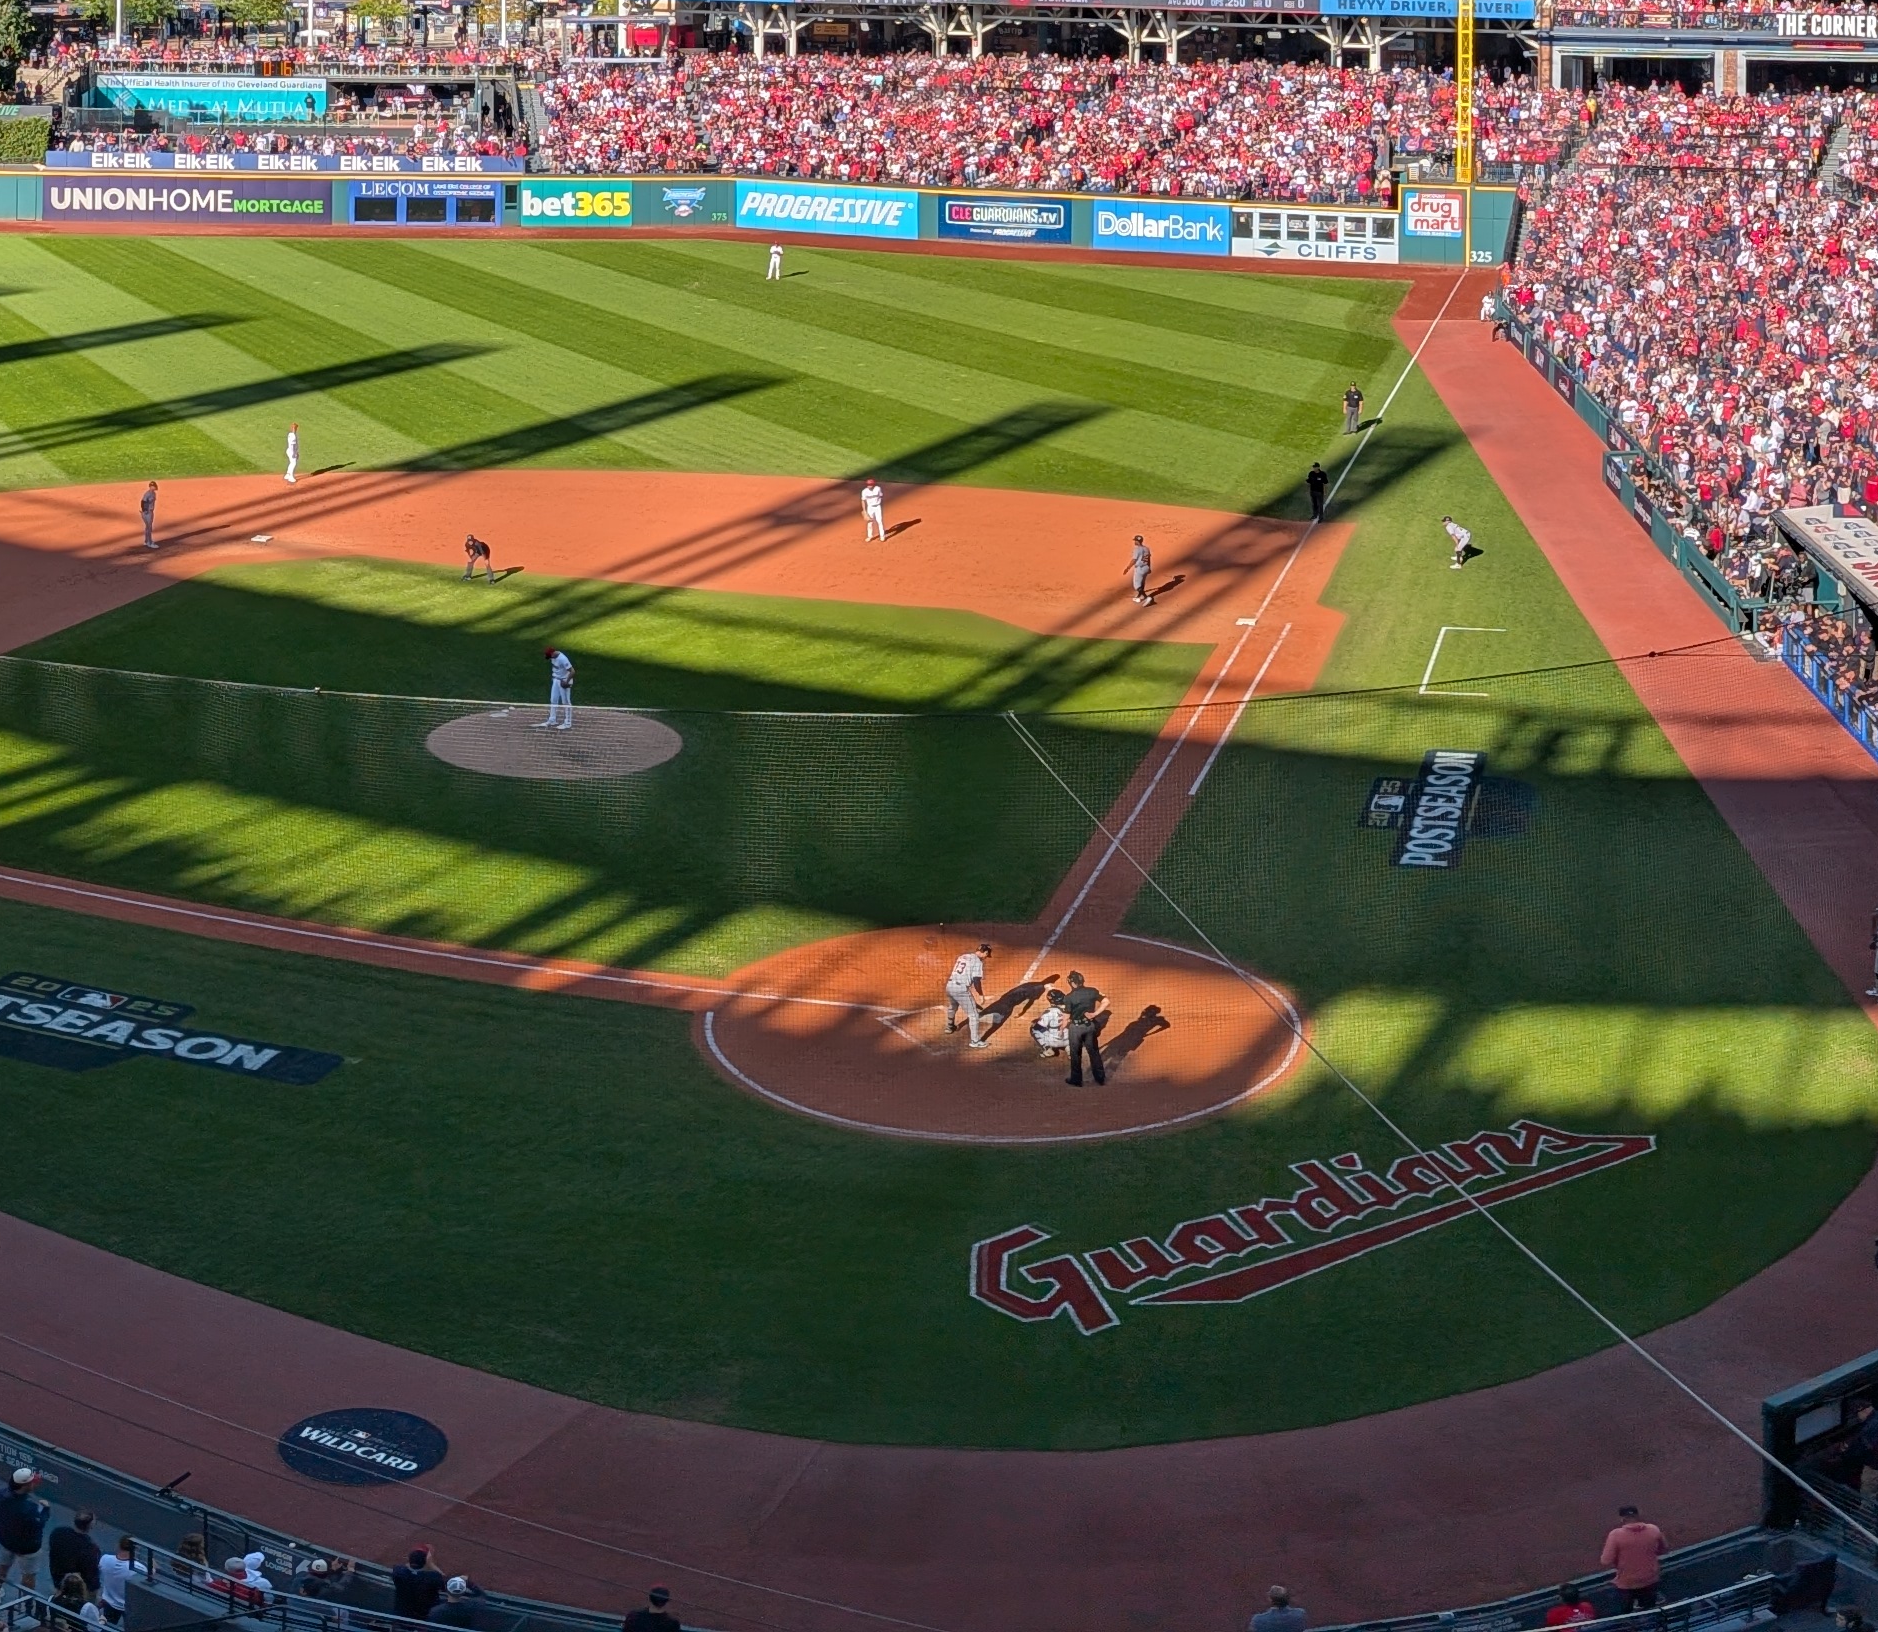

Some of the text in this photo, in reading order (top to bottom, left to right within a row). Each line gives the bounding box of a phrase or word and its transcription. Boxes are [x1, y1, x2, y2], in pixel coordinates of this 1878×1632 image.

[1337, 0, 1385, 11] HEYYY
[1776, 14, 1878, 38] THE CORNER
[122, 79, 322, 89] Official Health Insurer Cleveland Guardians
[233, 200, 323, 214] MORTGAGE
[523, 190, 631, 217] bet365
[740, 192, 905, 226] PROGRESSIVE
[1409, 198, 1452, 219] drug
[1414, 215, 1460, 231] mart
[1297, 243, 1377, 261] CLIFFS
[1470, 251, 1492, 263] 325
[1399, 751, 1478, 867] POSTSEASON
[969, 1120, 1657, 1336] Guardians
[297, 1426, 419, 1472] WILDCARD
